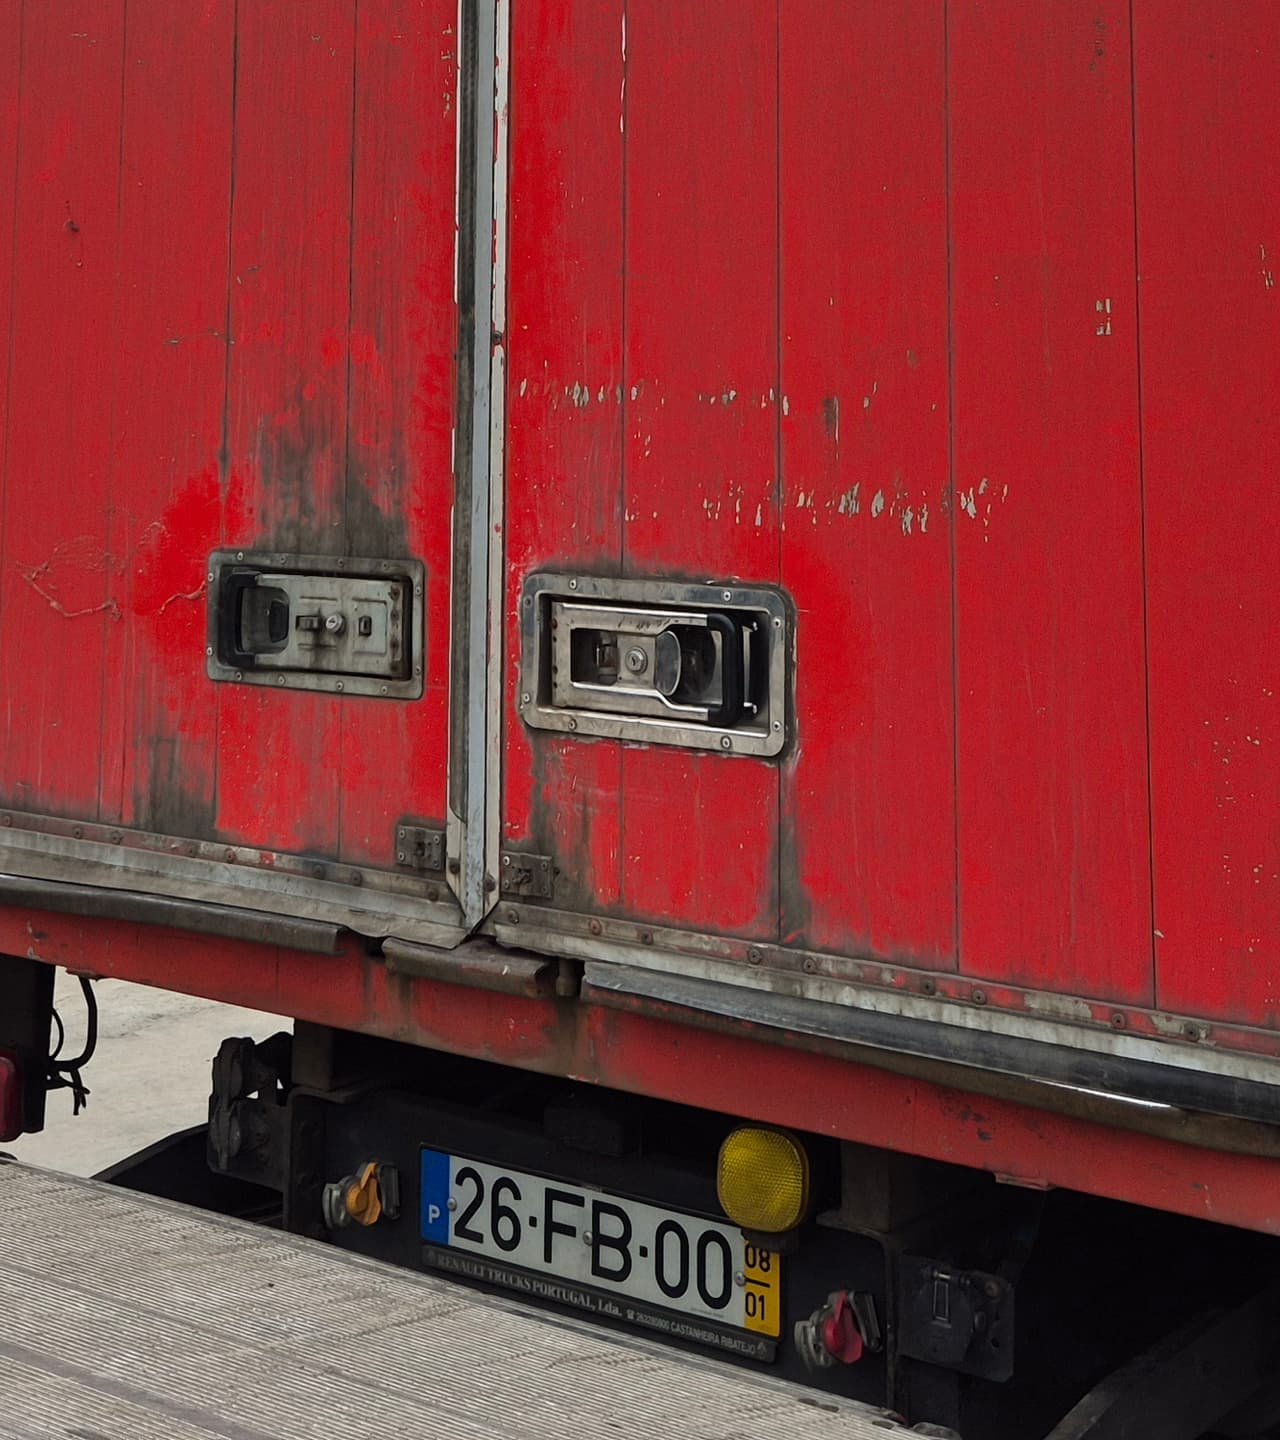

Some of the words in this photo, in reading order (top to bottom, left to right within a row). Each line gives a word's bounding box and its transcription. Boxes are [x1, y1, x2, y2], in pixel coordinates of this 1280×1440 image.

[428, 1204, 441, 1224] P
[744, 1242, 771, 1273] 08
[437, 1254, 485, 1278] RENAULT
[487, 1269, 532, 1291] TRUCKS
[532, 1280, 596, 1311] PORTUGAL,
[745, 1291, 765, 1320] 01
